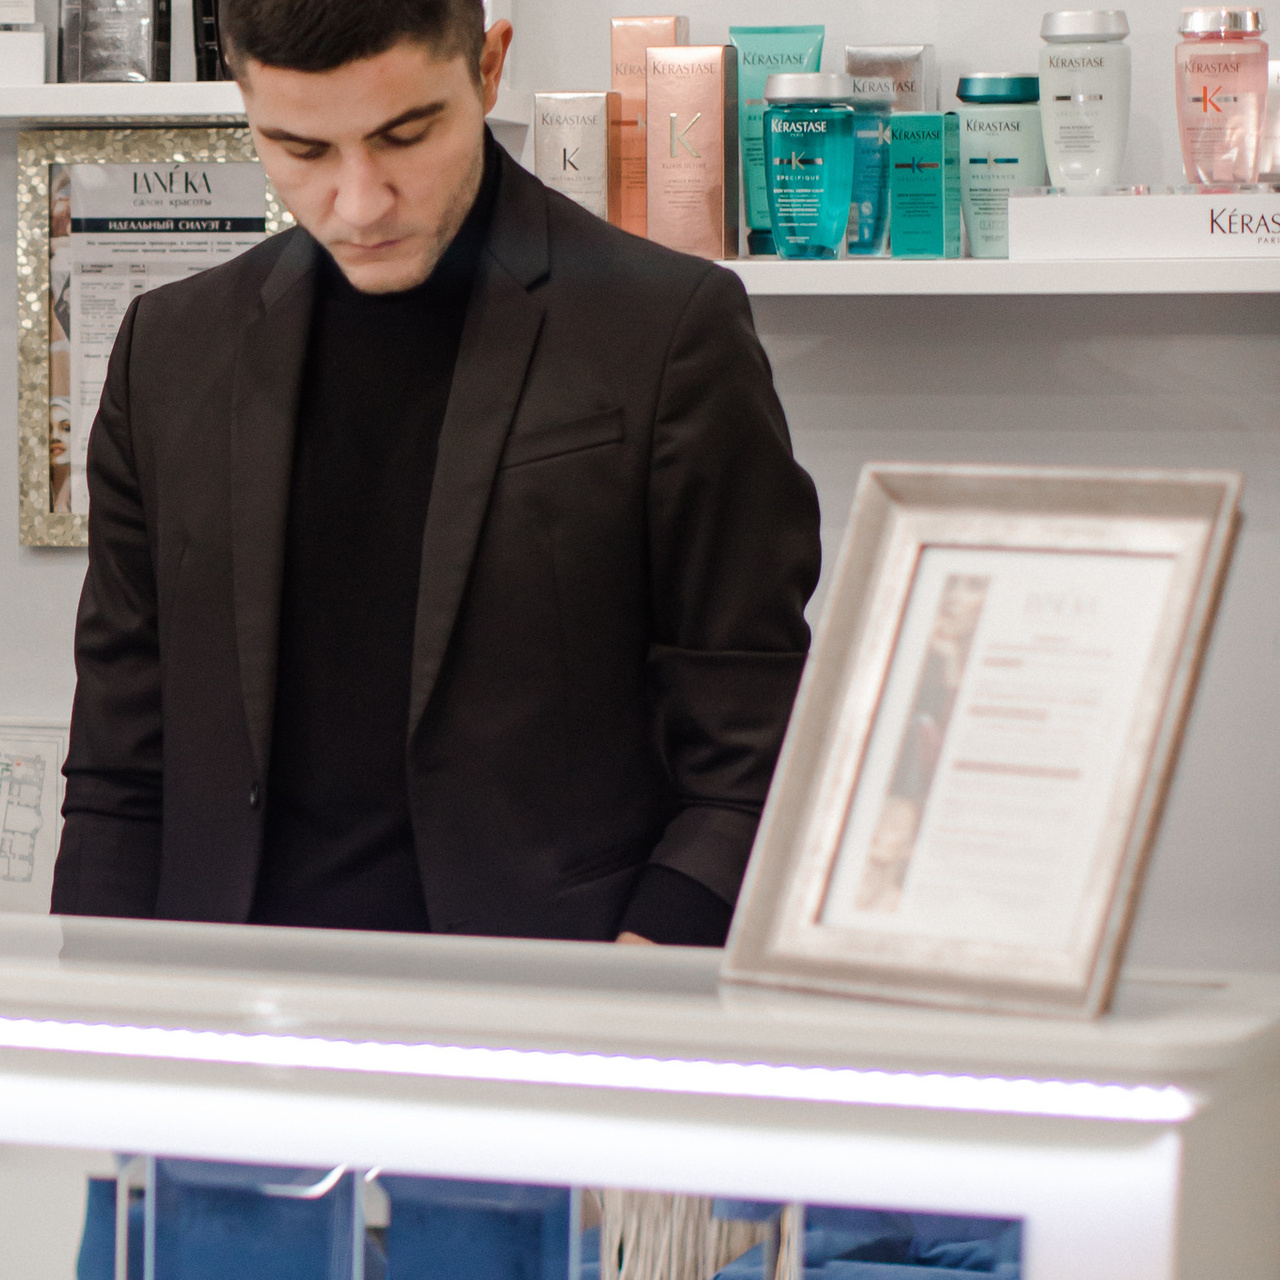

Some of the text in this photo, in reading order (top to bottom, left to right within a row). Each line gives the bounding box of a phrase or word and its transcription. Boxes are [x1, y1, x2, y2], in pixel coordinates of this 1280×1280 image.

[743, 51, 805, 66] KÉRASTASE
[1049, 56, 1105, 69] KÉRASTASE
[652, 60, 717, 76] KÉRASTASE
[1184, 61, 1241, 74] KÉRASTASE
[1202, 85, 1223, 113] K
[541, 112, 598, 126] KÉRASTASE
[771, 118, 827, 133] KÉRASTASE
[966, 119, 1021, 132] KÉRASTASE
[669, 112, 702, 159] K
[891, 129, 941, 141] KÉRASTASE
[563, 147, 580, 171] K
[791, 151, 806, 170] K
[169, 199, 212, 208] красоты
[108, 219, 232, 231] ИДЕАЛЬНЫЙ СИЛУЭТ 2
